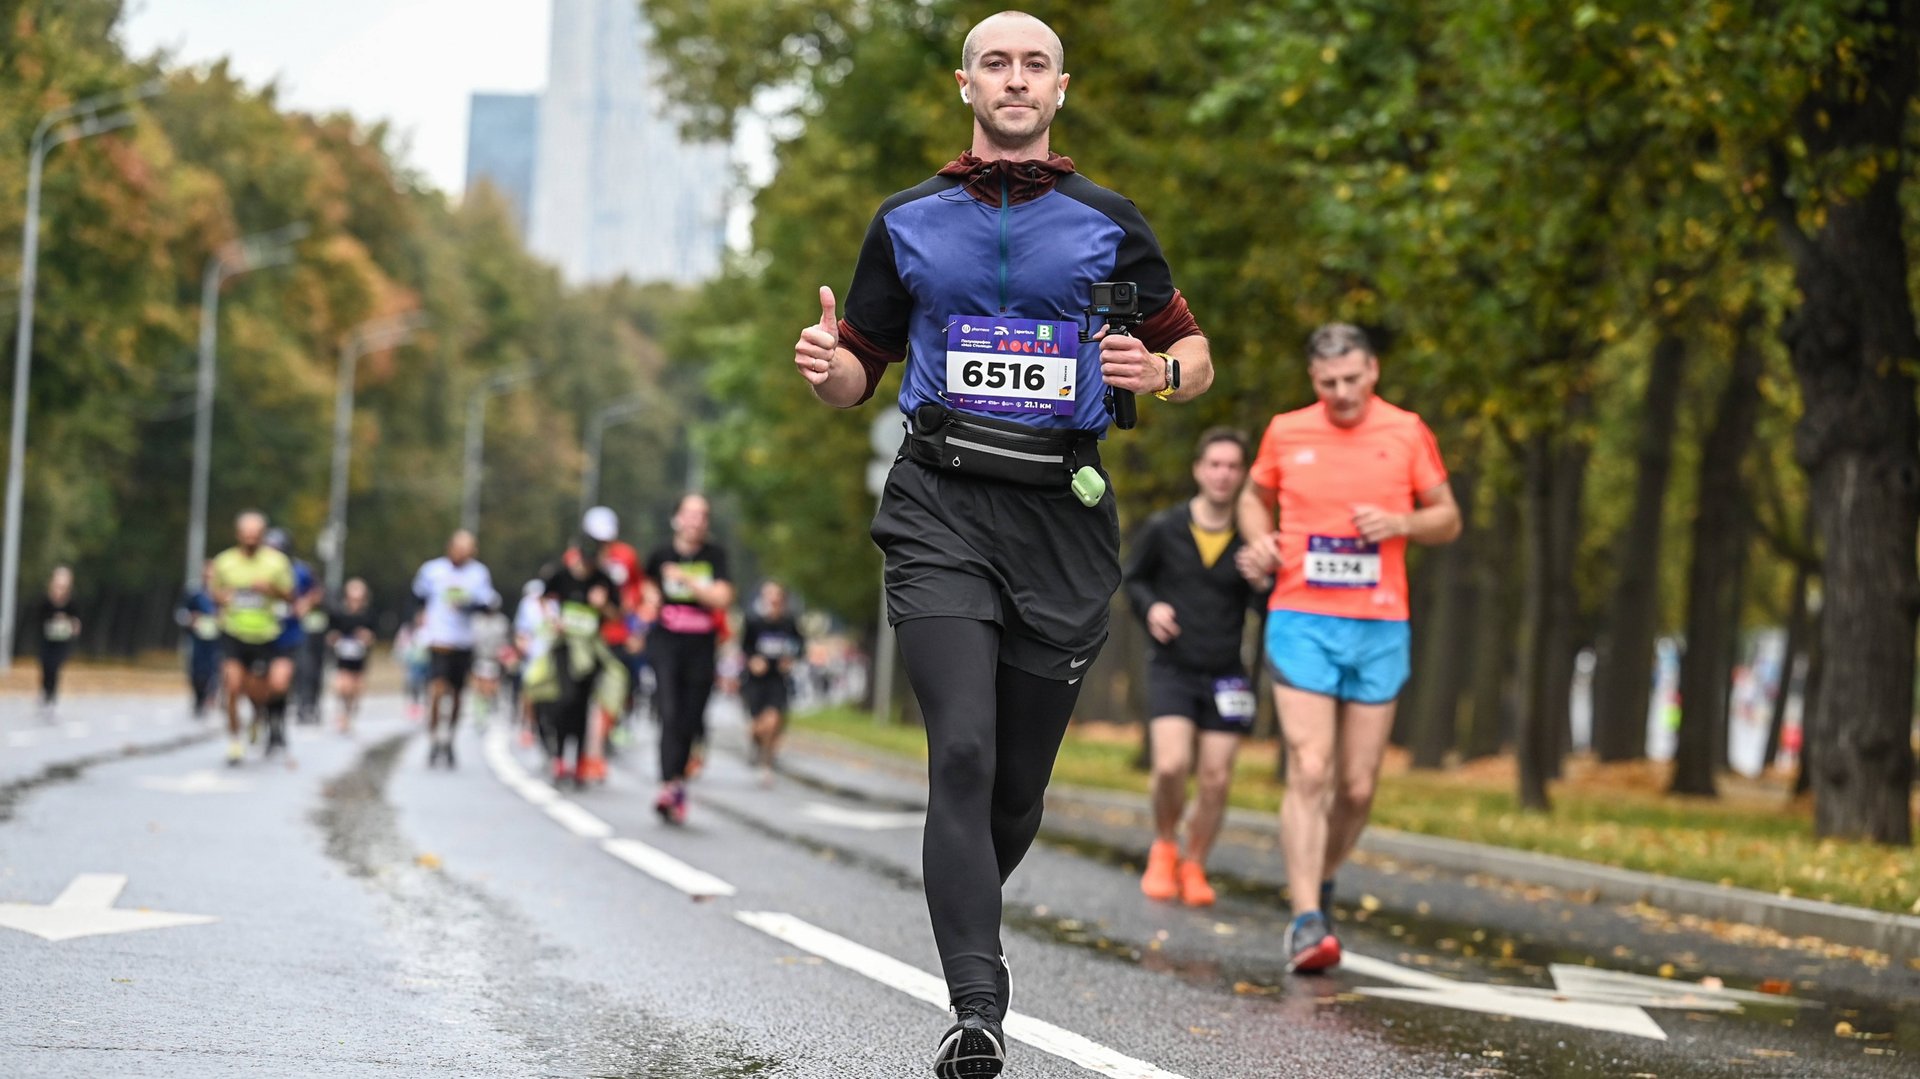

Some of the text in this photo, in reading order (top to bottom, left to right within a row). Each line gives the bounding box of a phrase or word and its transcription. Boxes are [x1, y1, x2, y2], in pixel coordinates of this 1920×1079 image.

[997, 340, 1060, 354] МОСКВА
[962, 360, 1045, 391] 6516
[1024, 401, 1038, 409] 21.1
